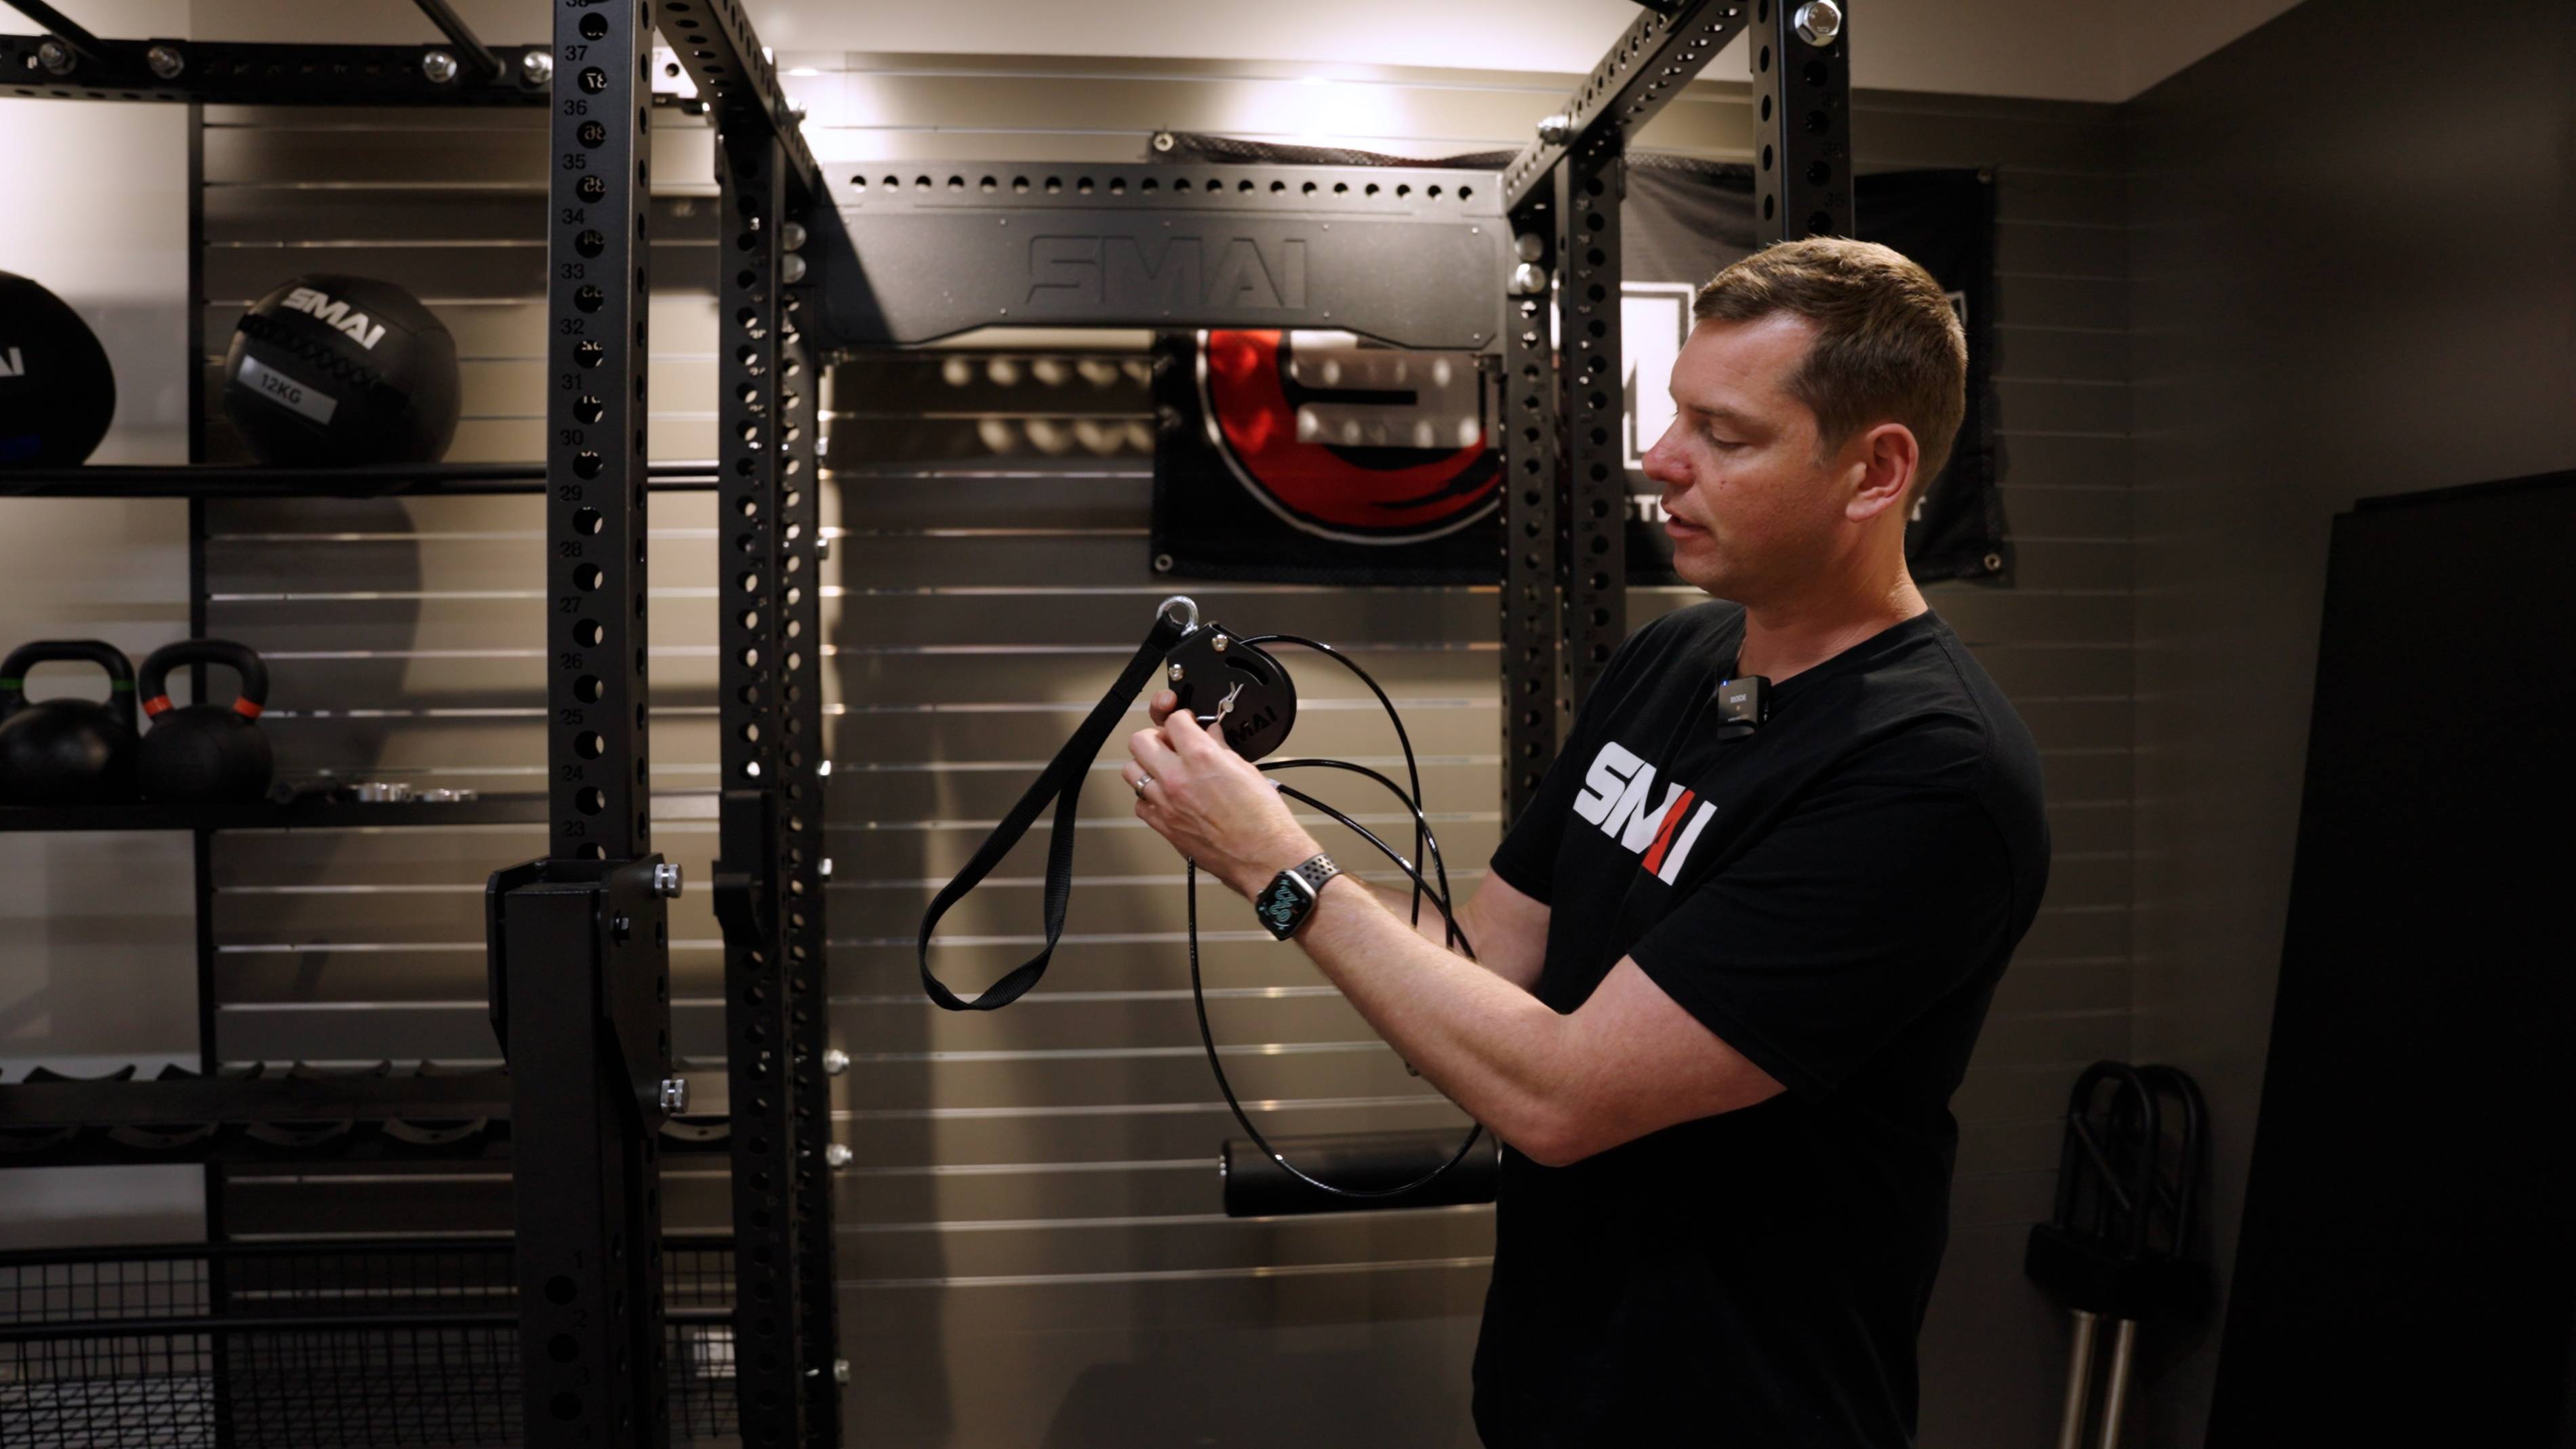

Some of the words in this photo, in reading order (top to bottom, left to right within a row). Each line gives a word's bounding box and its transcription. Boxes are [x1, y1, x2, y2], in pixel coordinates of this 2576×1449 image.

[565, 45, 588, 61] 37
[563, 99, 588, 116] 36
[562, 153, 586, 170] 35
[562, 207, 585, 225] 34
[561, 264, 584, 280] 33
[1025, 234, 1307, 310] SMAI
[280, 287, 386, 350] SMAI
[560, 319, 584, 335] 32
[260, 372, 302, 406] 12KG
[561, 373, 582, 390] 31
[559, 429, 584, 446] 30
[559, 485, 582, 502] 29
[559, 541, 582, 558] 28
[560, 596, 582, 613] 27
[560, 653, 583, 670] 26
[560, 709, 584, 726] 25
[1226, 706, 1277, 746] MAI
[561, 764, 584, 781] 24
[562, 821, 586, 837] 23
